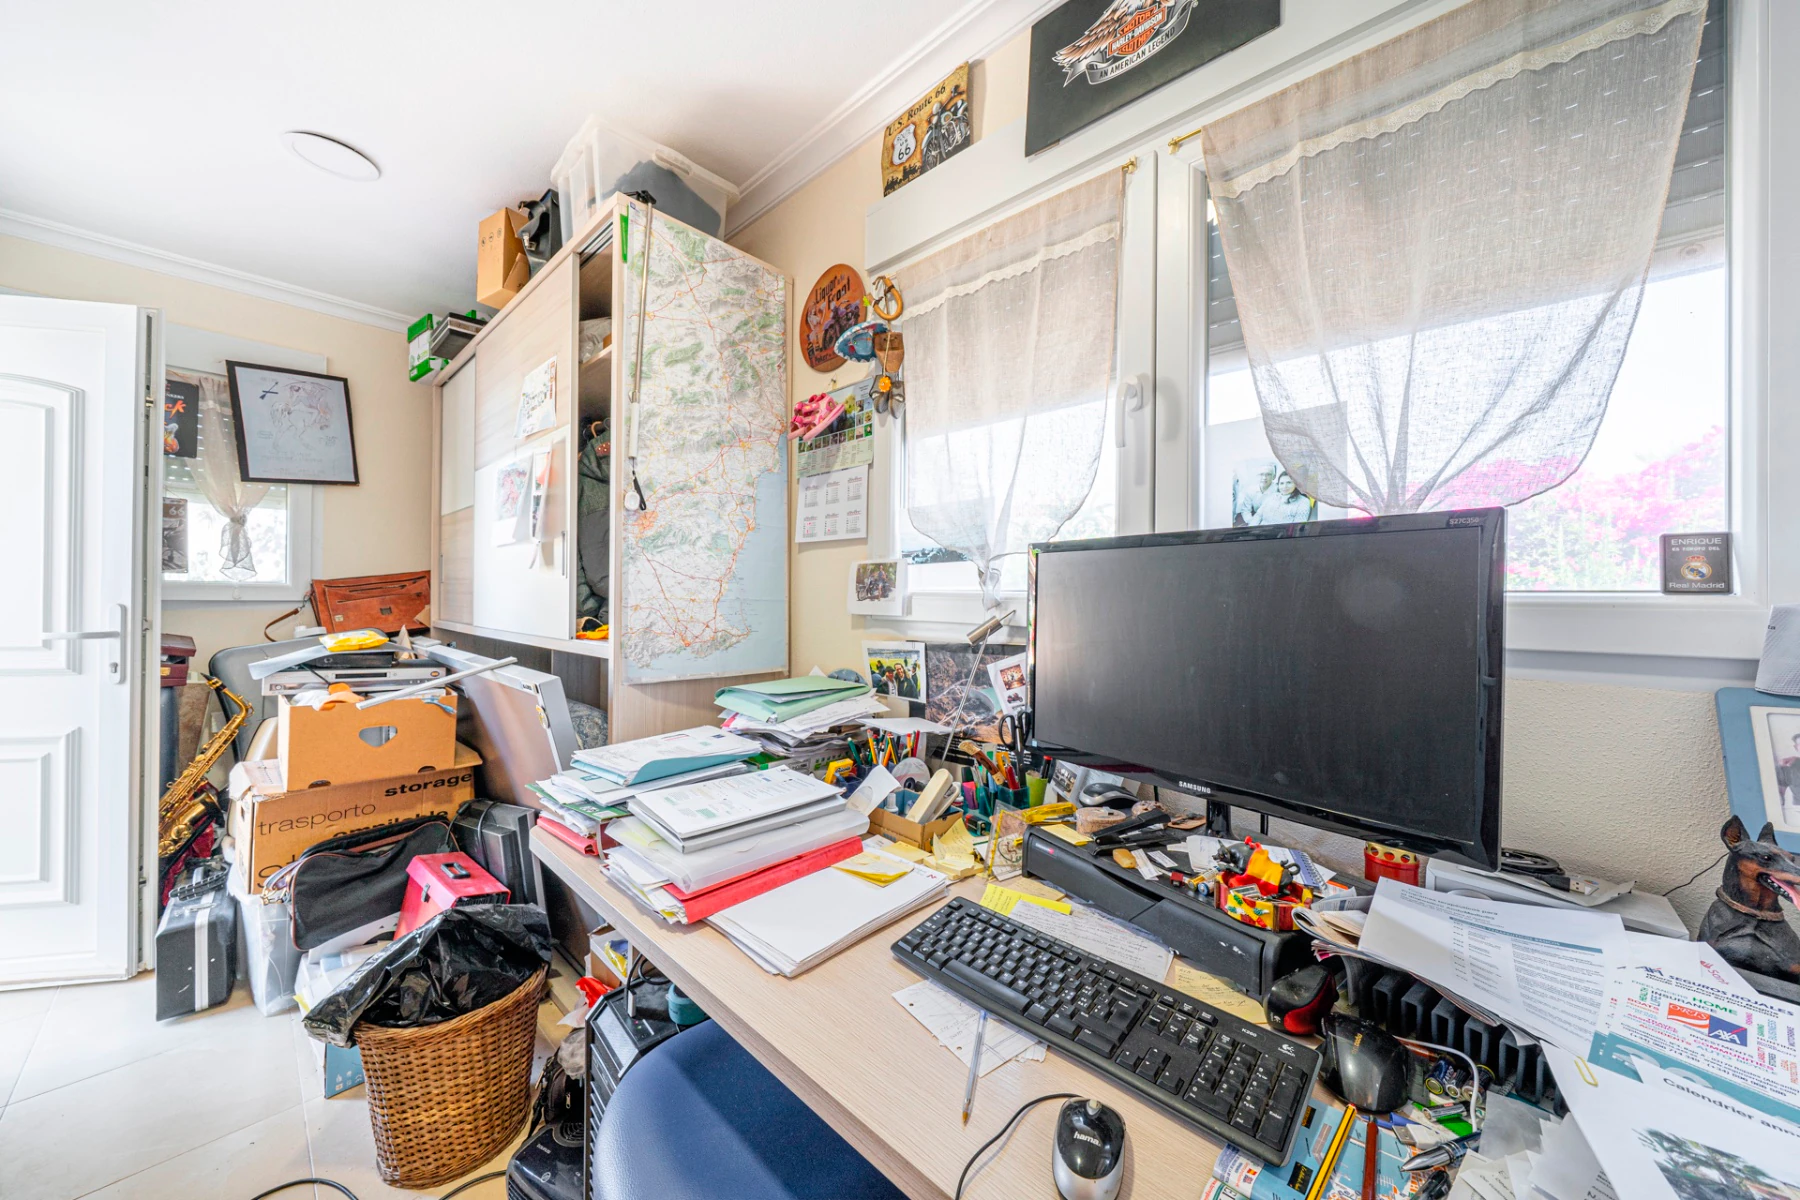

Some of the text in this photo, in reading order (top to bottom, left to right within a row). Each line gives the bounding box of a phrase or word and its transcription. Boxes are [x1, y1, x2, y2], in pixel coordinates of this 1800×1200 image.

[1111, 11, 1163, 50] HARLEY-DAVIDSON
[1099, 26, 1176, 79] AN AMERICAN LEGEND
[908, 95, 933, 121] Route
[935, 85, 946, 99] 66
[898, 145, 911, 161] 66
[815, 276, 837, 304] Liquor
[827, 276, 850, 310] Front
[1671, 537, 1722, 546] ENRIQUE
[384, 771, 473, 798] storage
[1178, 780, 1212, 794] SAMSUNG
[257, 802, 376, 837] trasporto
[1627, 997, 1659, 1010] BOATS
[1651, 990, 1716, 1013] INSURANCE
[1669, 975, 1728, 996] SEGUROS
[1731, 993, 1793, 1016] ROJALES
[1691, 996, 1737, 1015] HOME
[1241, 1027, 1258, 1038] K260
[1638, 1023, 1692, 1046] ACCIDENTS
[1708, 1029, 1741, 1044] AXA
[1757, 1036, 1795, 1051] HUNTING
[1689, 1033, 1753, 1058] INVESTMENTS
[1693, 1039, 1774, 1071] COMMUNITIES
[1696, 1044, 1731, 1060] AUTO
[1663, 1078, 1800, 1138] Calendrier ann
